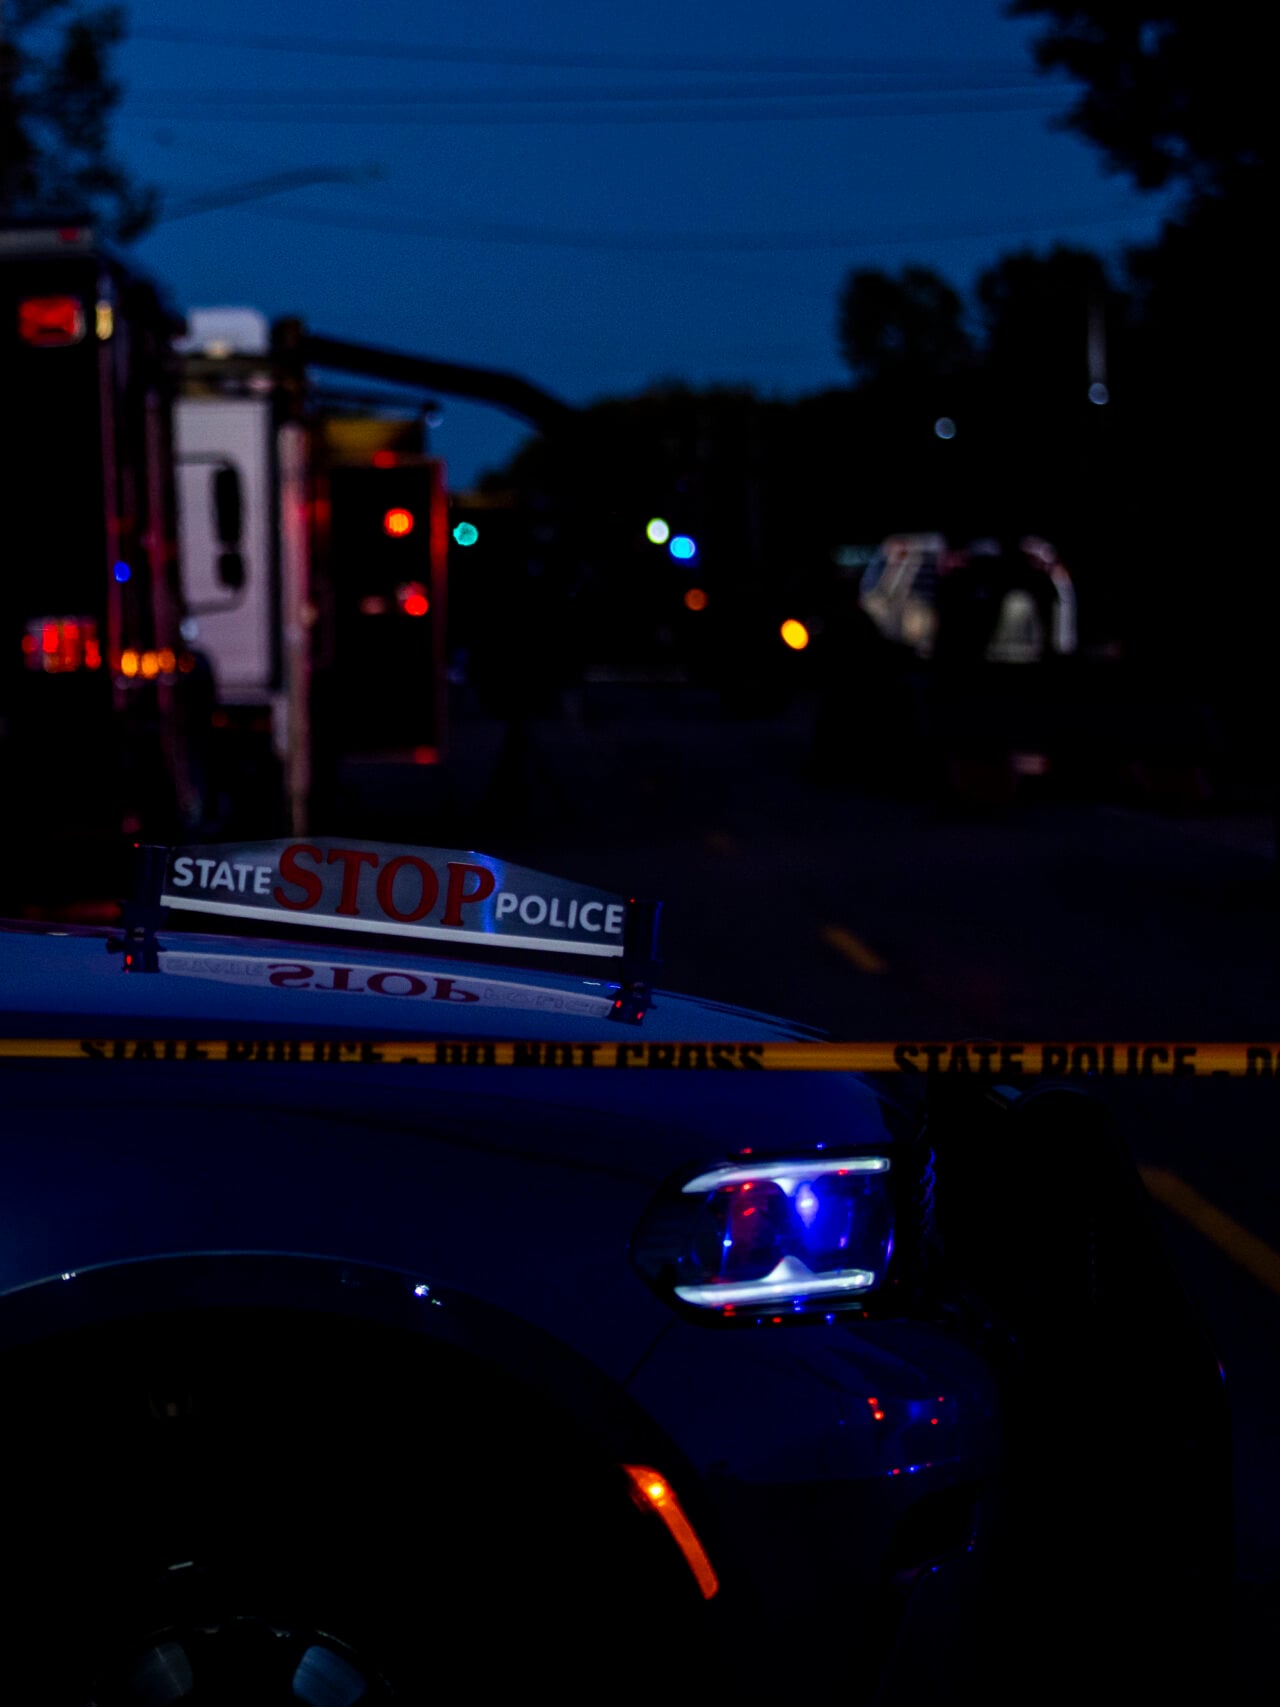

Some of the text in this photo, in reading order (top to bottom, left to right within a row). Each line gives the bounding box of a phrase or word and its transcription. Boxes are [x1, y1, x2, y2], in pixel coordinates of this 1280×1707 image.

[172, 844, 625, 935] STATE STOP POLICE
